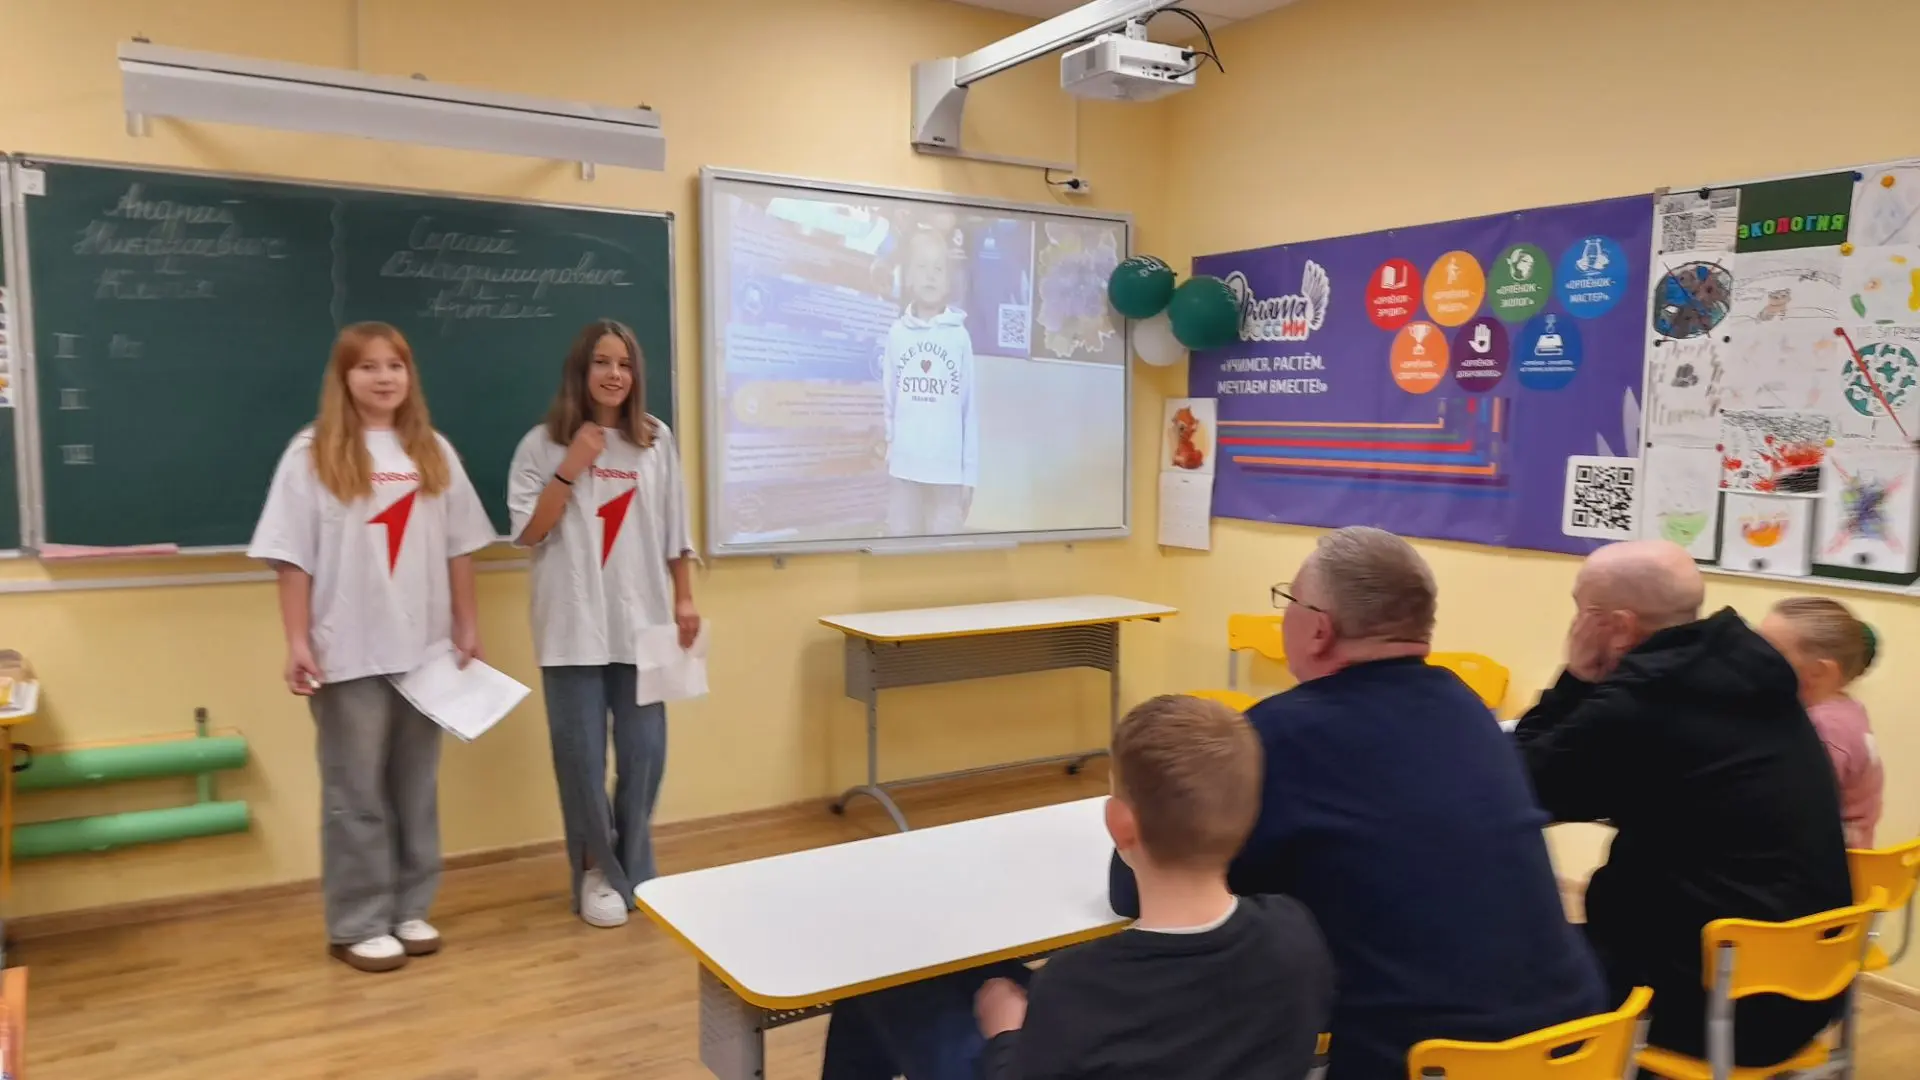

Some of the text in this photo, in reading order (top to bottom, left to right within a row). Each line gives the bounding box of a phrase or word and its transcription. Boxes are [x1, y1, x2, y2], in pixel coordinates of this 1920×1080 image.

[408, 215, 519, 262] Сергей
[1738, 214, 1846, 239] ЭКОЛОГИЯ
[379, 250, 635, 300] Владимирович
[916, 341, 948, 361] YOUR
[946, 359, 961, 396] OWN
[902, 376, 948, 396] STORY
[1217, 380, 1269, 395] МЕЧТАЕМ
[370, 471, 421, 485] ервые
